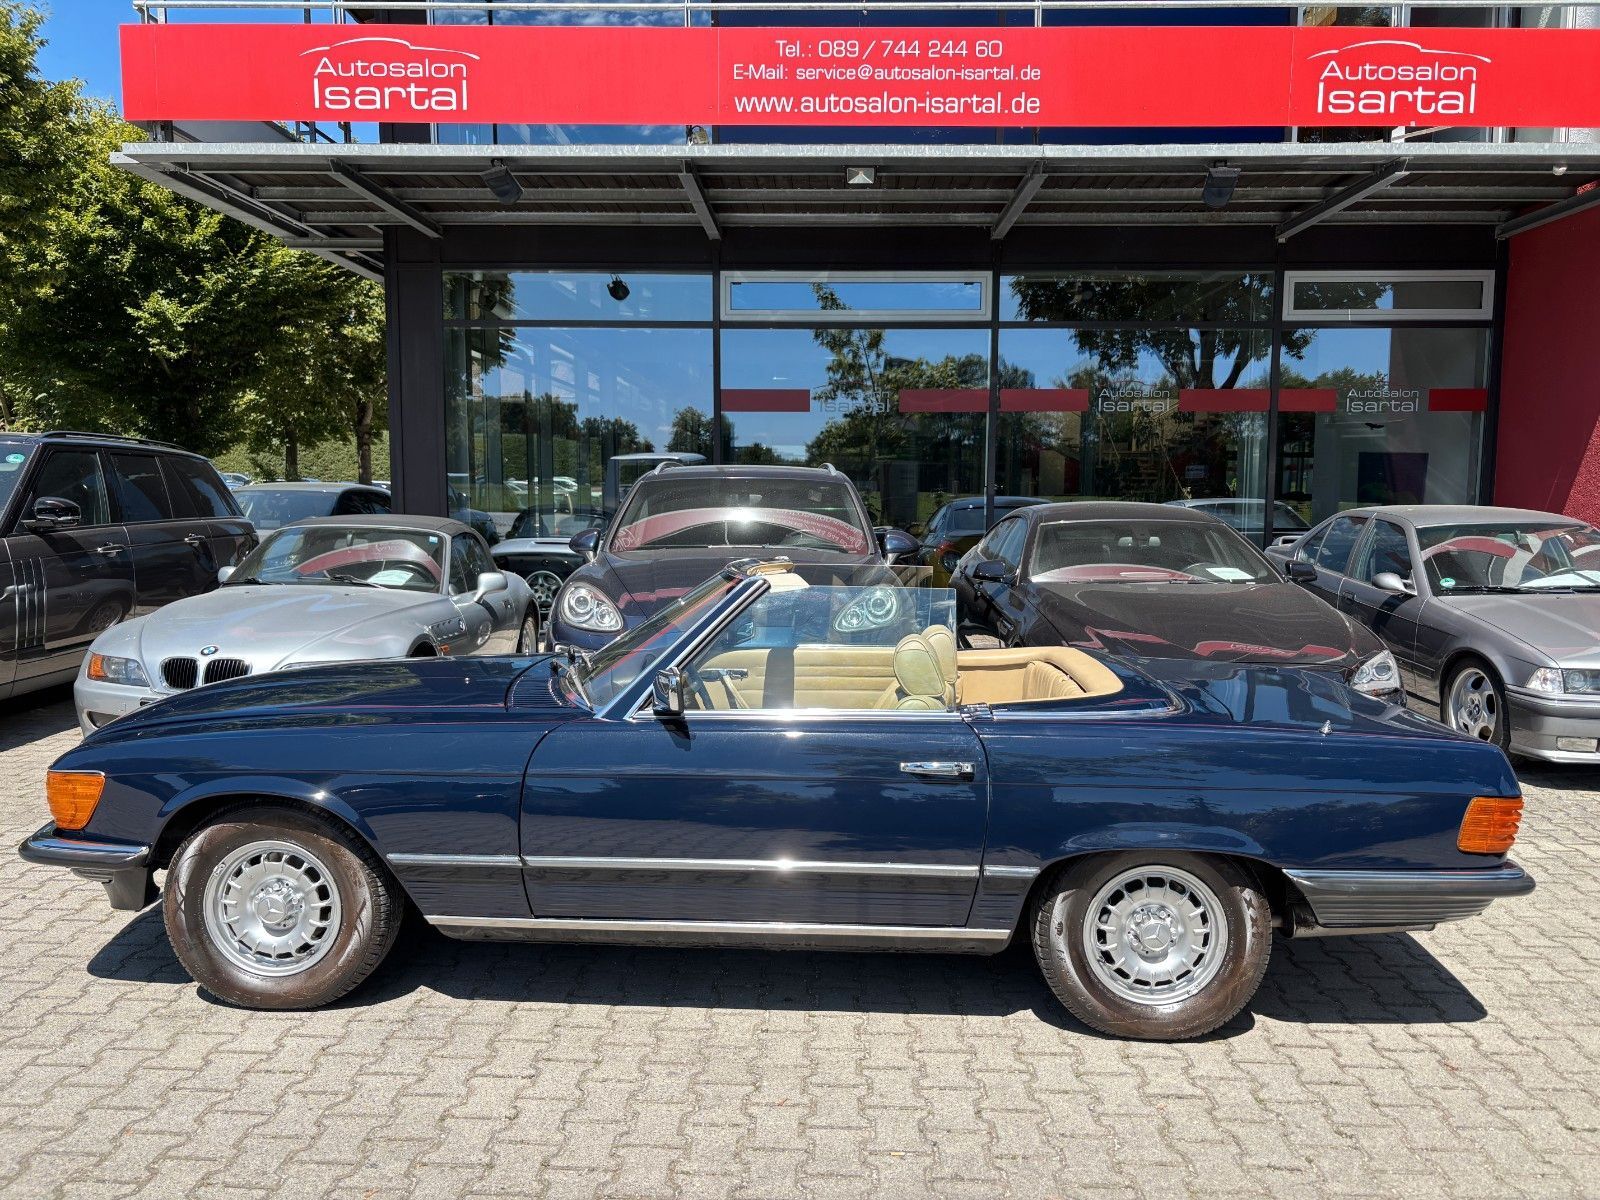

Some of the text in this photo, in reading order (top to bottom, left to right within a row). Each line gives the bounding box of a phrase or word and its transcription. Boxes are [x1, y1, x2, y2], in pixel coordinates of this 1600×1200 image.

[775, 40, 812, 58] Tel.:
[928, 40, 968, 58] 244
[976, 40, 1003, 58] 60
[314, 57, 467, 78] Autosalon
[733, 64, 1041, 81] E-Mail: service@autosalon-isartal.de
[1320, 60, 1477, 81] Autosalon
[313, 77, 468, 111] Isartal
[734, 91, 1041, 114] www.autosalon-isartal.de
[1317, 82, 1476, 114] Isartal
[1099, 388, 1170, 398] Autosalon
[1347, 388, 1419, 398] Autosalon
[1098, 397, 1170, 412] Isartal
[1346, 397, 1419, 412] Isartal
